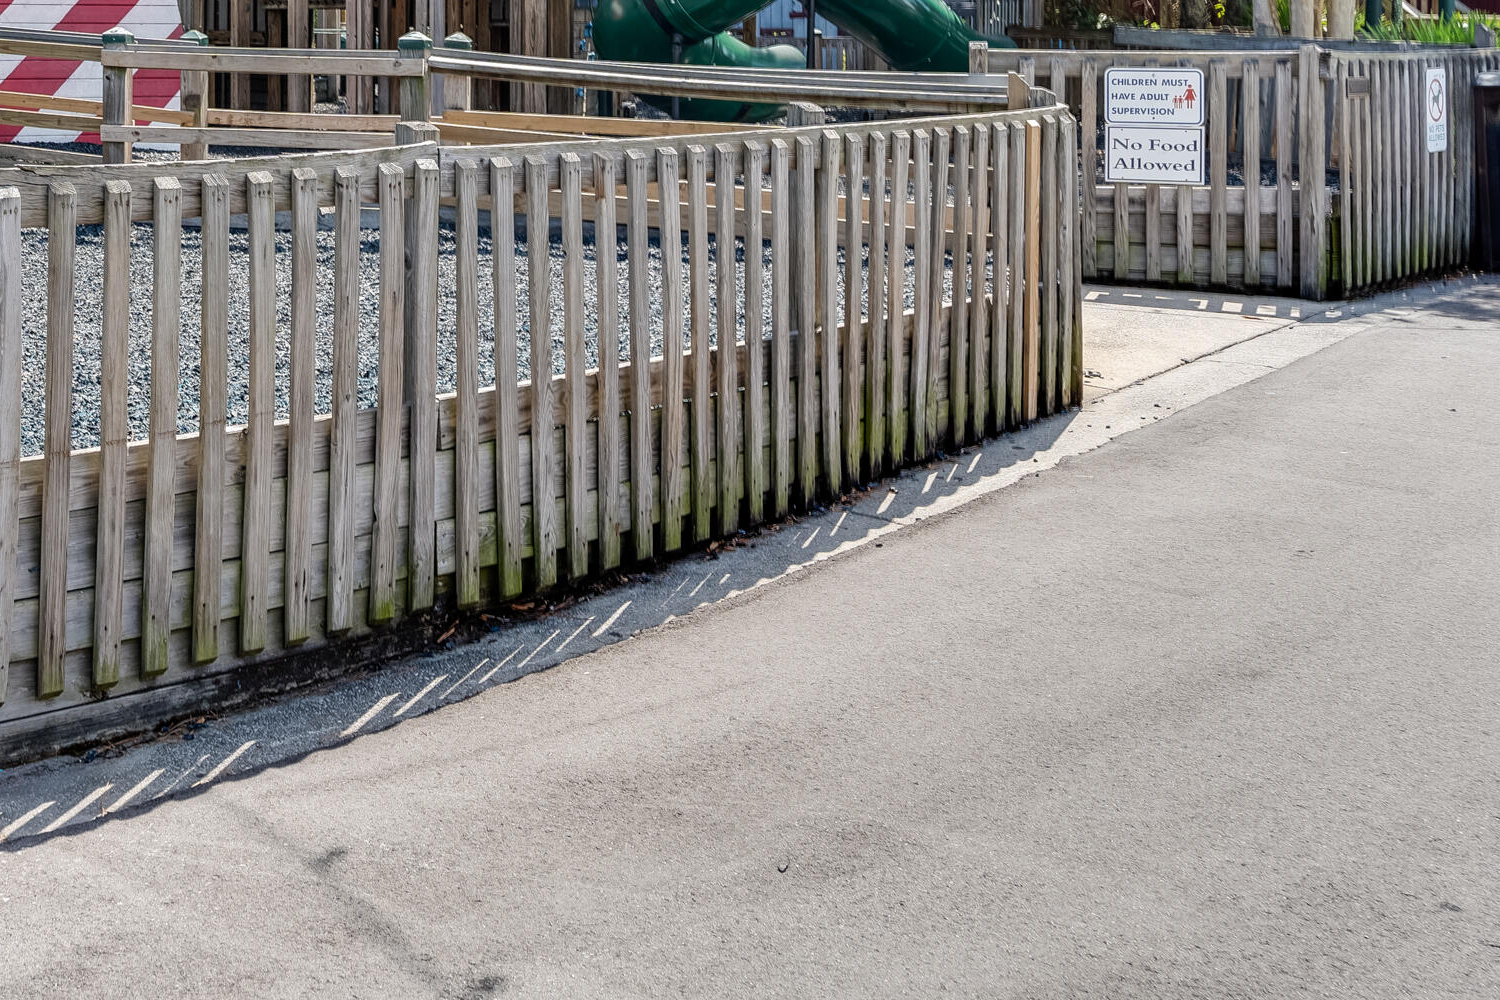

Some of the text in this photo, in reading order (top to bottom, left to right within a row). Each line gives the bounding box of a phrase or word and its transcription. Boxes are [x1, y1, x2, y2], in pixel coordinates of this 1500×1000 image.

[1111, 78, 1189, 87] CHILDREN MUST
[1111, 93, 1170, 101] HAVE ADULT
[1111, 107, 1175, 116] SUPERVISION
[1436, 124, 1445, 132] PETS
[1112, 138, 1199, 152] No Food
[1114, 157, 1196, 172] Allowed
